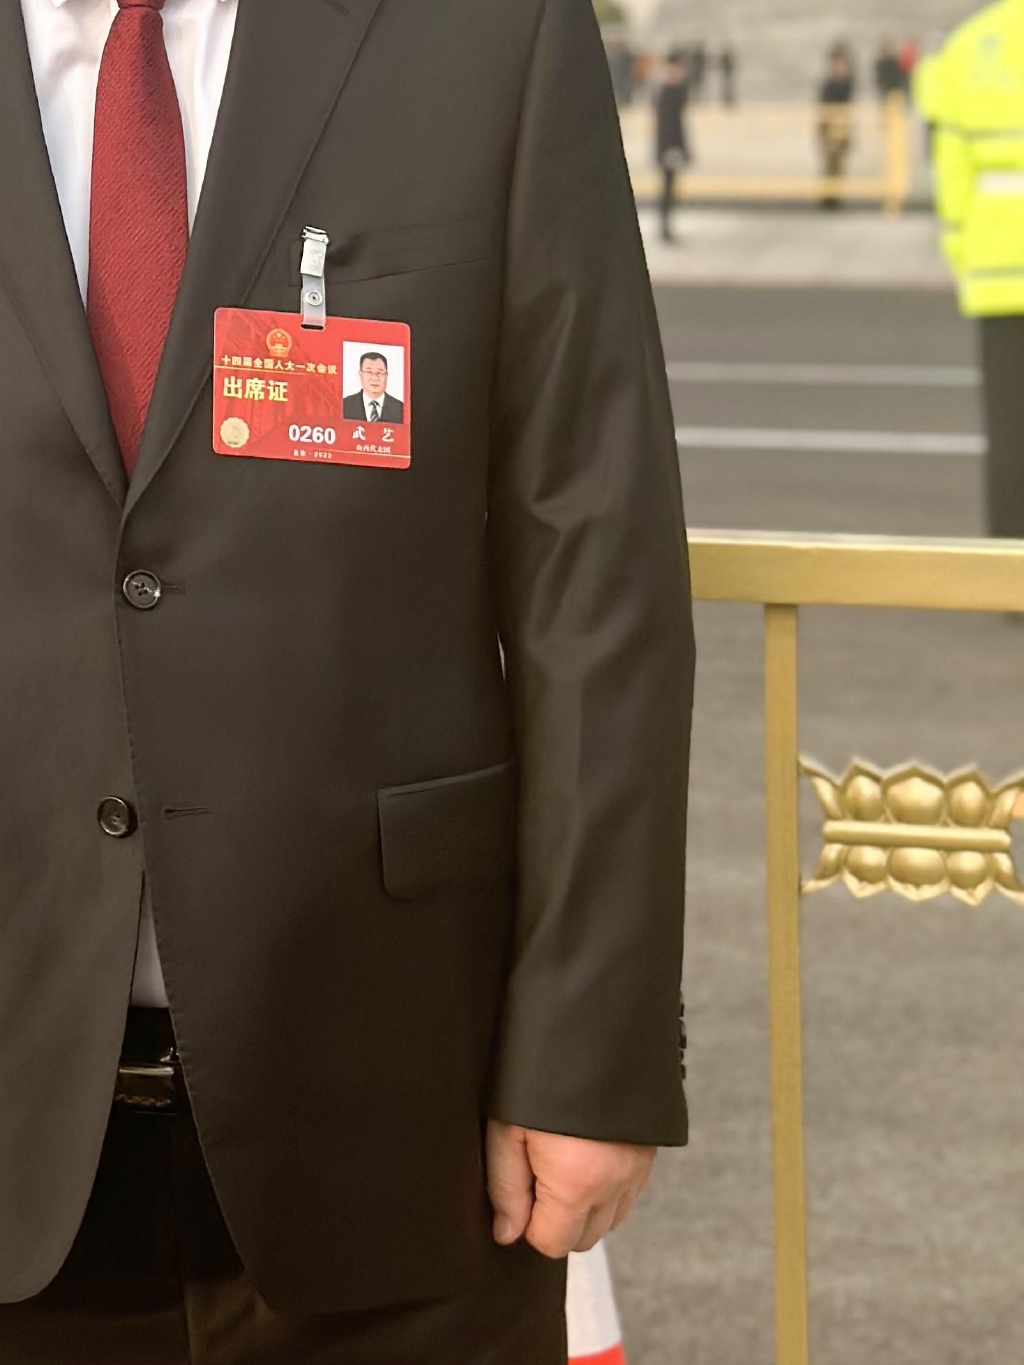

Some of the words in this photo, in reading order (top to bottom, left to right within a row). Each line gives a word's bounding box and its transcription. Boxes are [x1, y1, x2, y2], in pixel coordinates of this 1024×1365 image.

[221, 354, 338, 375] 十四届全国人大一次会议
[223, 375, 289, 402] 出席证
[288, 424, 336, 445] 0260
